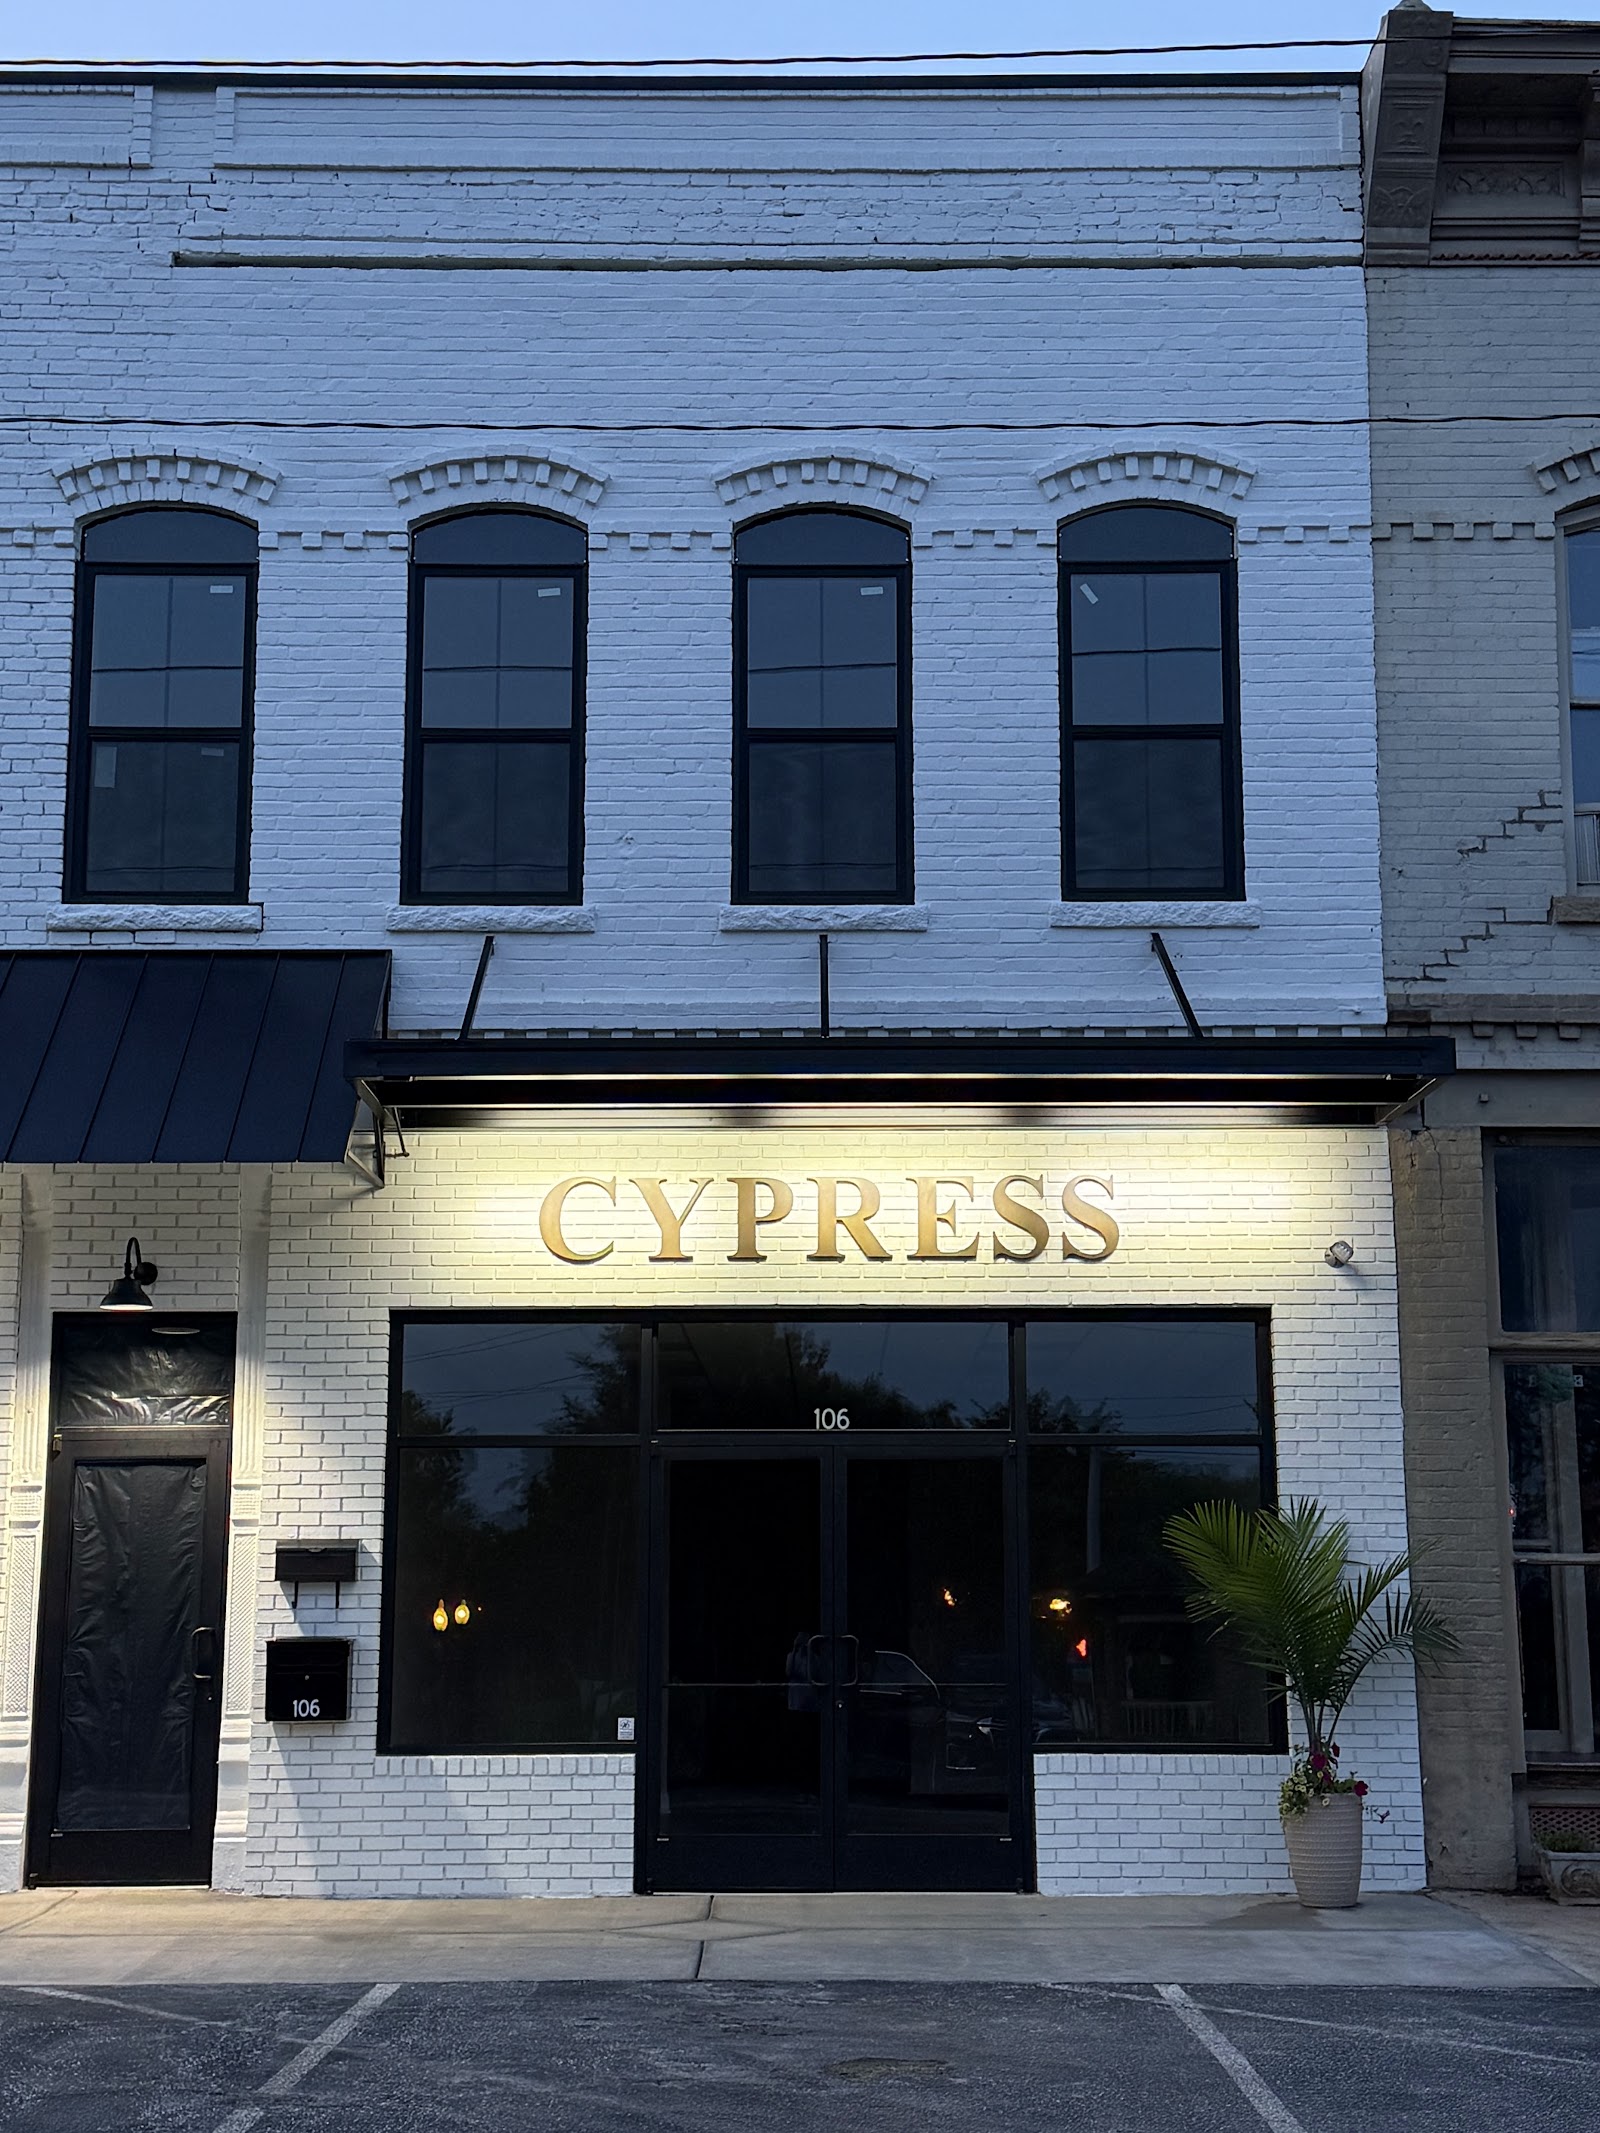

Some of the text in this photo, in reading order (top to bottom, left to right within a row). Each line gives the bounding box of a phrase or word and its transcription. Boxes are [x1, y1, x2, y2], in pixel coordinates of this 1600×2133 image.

[539, 1174, 1120, 1264] CYPRESS
[813, 1407, 850, 1430] 106
[292, 1698, 321, 1718] 106
